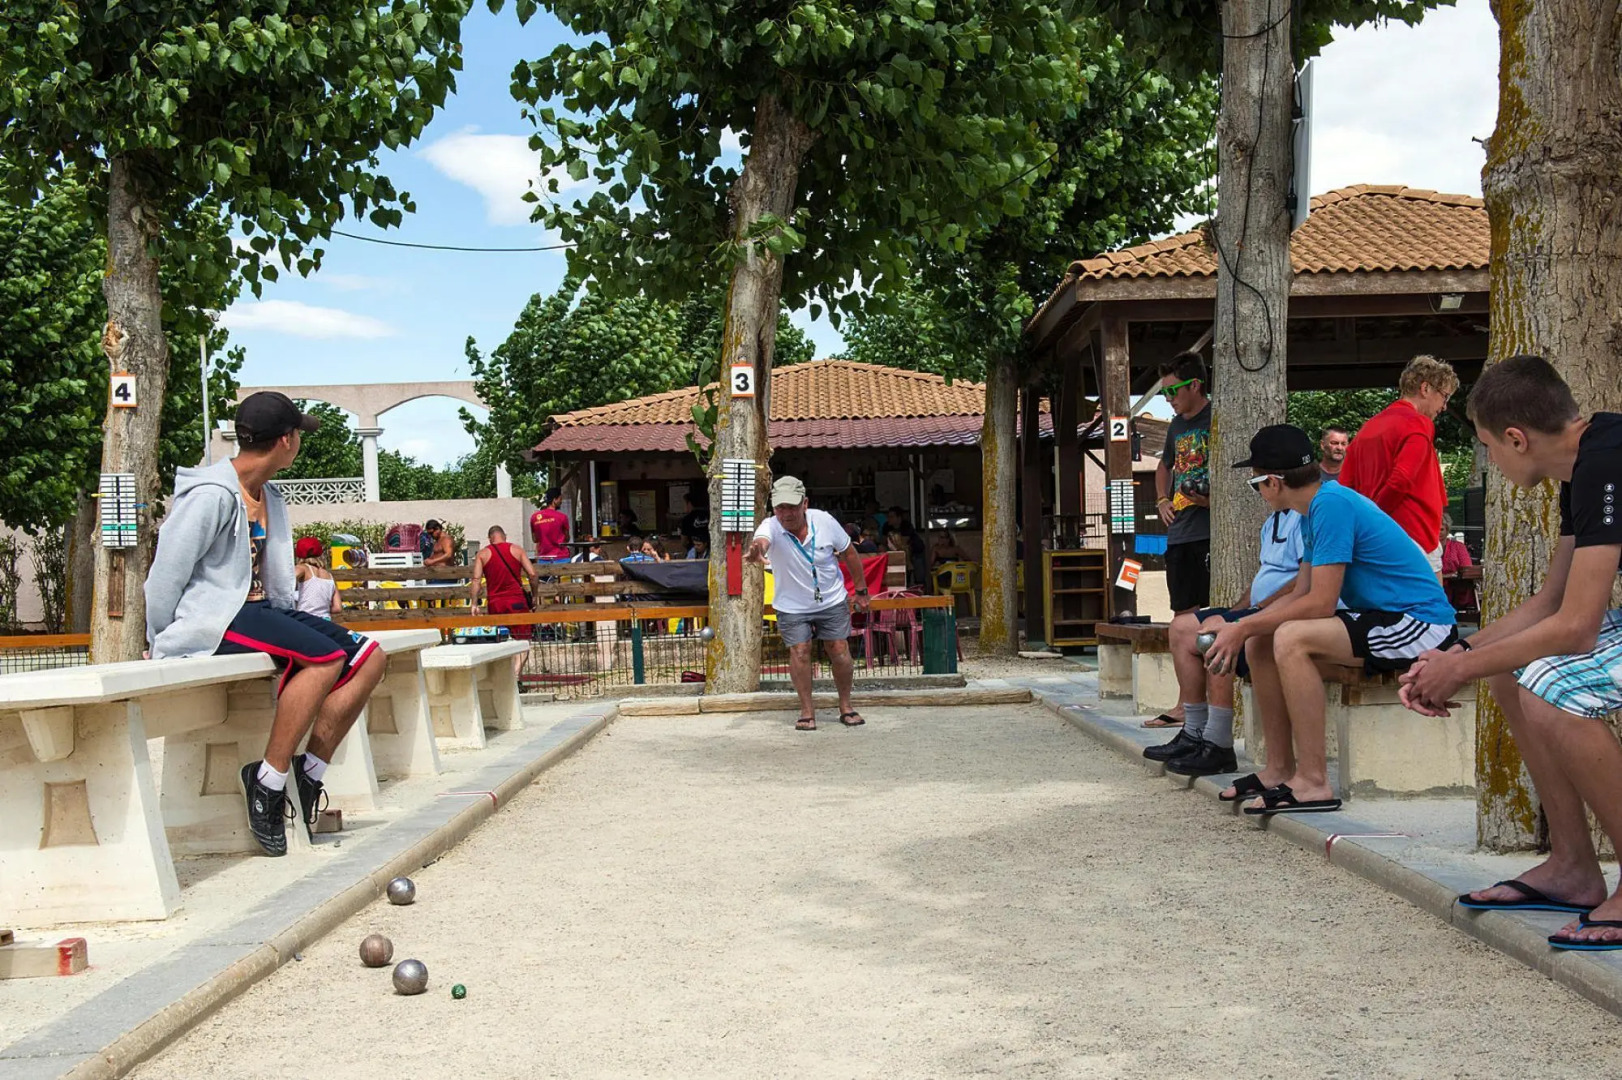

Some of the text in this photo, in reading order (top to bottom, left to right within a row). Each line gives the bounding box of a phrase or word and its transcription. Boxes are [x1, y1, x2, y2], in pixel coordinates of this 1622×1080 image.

[114, 382, 131, 402] 4
[735, 372, 750, 392] 3
[1113, 422, 1125, 437] 2
